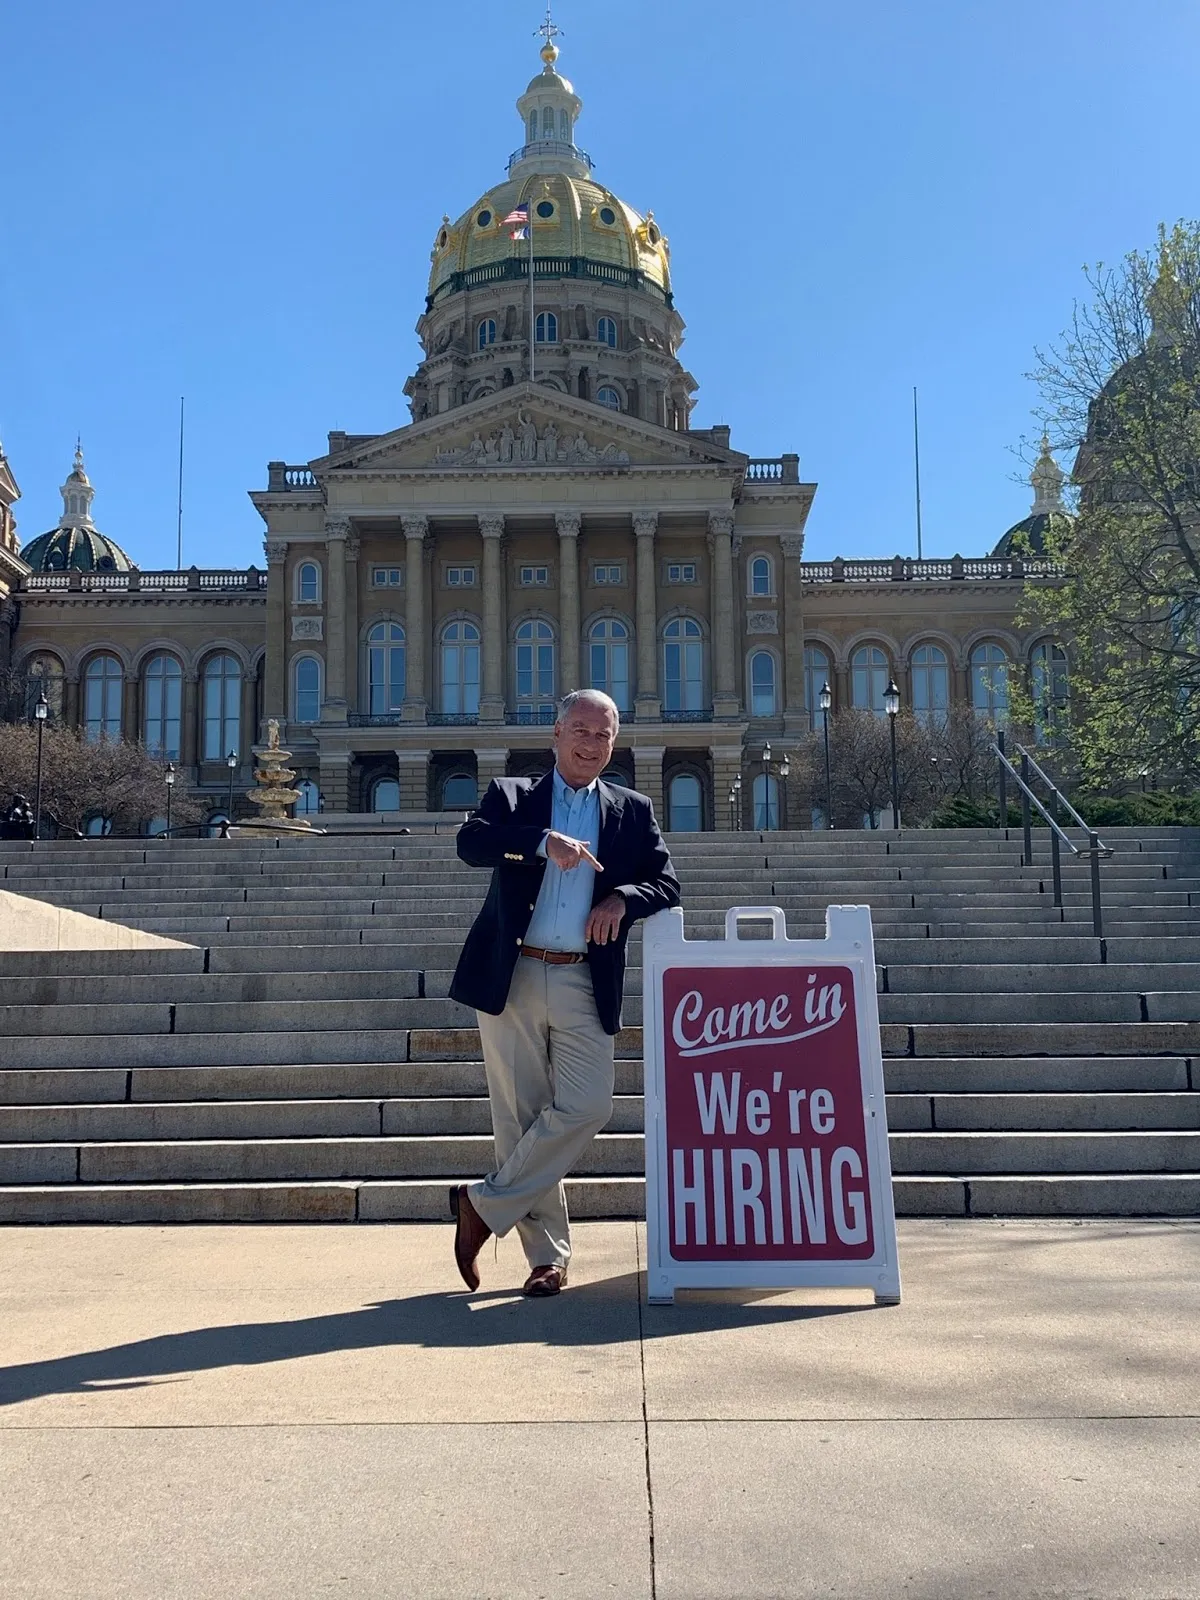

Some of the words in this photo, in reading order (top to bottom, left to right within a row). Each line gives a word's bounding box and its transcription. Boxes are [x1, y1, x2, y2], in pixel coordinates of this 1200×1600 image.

[672, 990, 792, 1049] Come
[804, 973, 847, 1024] in
[693, 1071, 836, 1136] We're
[672, 1145, 868, 1246] HIRING
